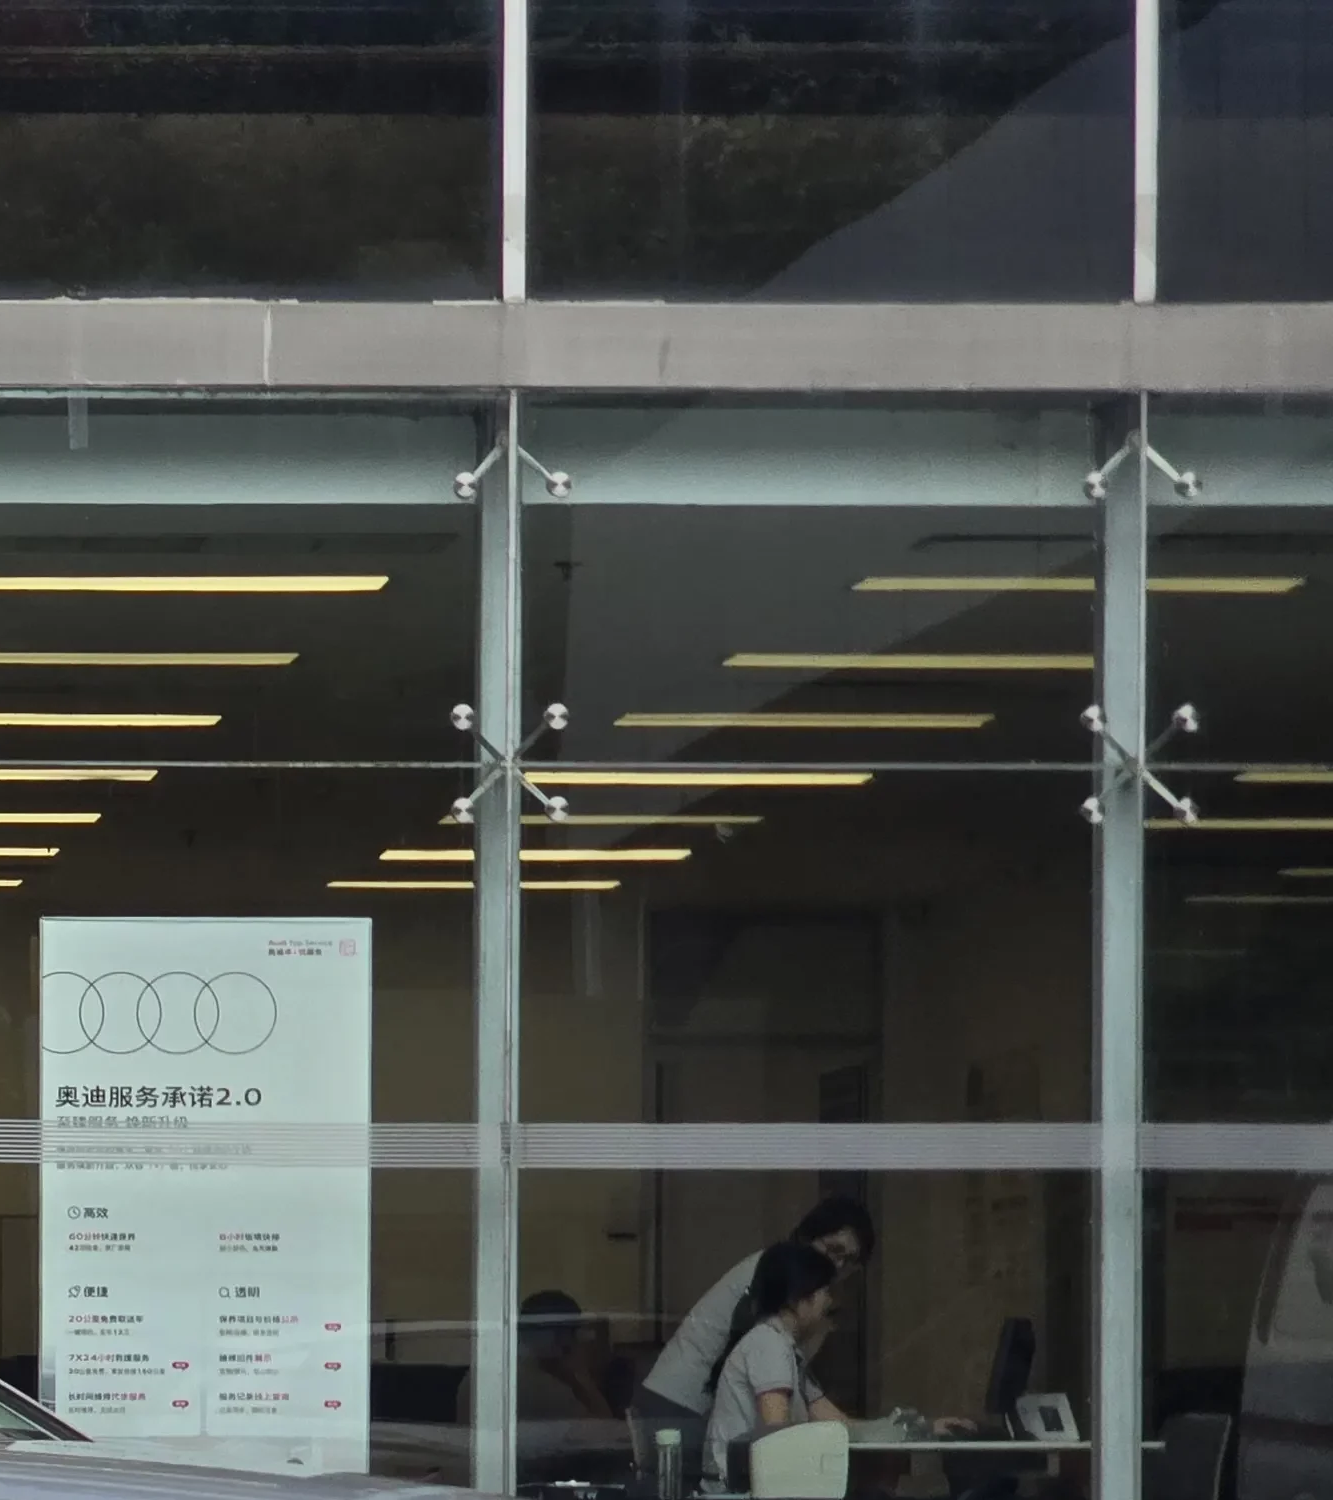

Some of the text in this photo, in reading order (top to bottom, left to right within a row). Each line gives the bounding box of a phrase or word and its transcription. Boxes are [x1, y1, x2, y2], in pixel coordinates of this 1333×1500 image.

[55, 1085, 263, 1109] 奥迪服务承诺2.0
[83, 1207, 109, 1219] 高效
